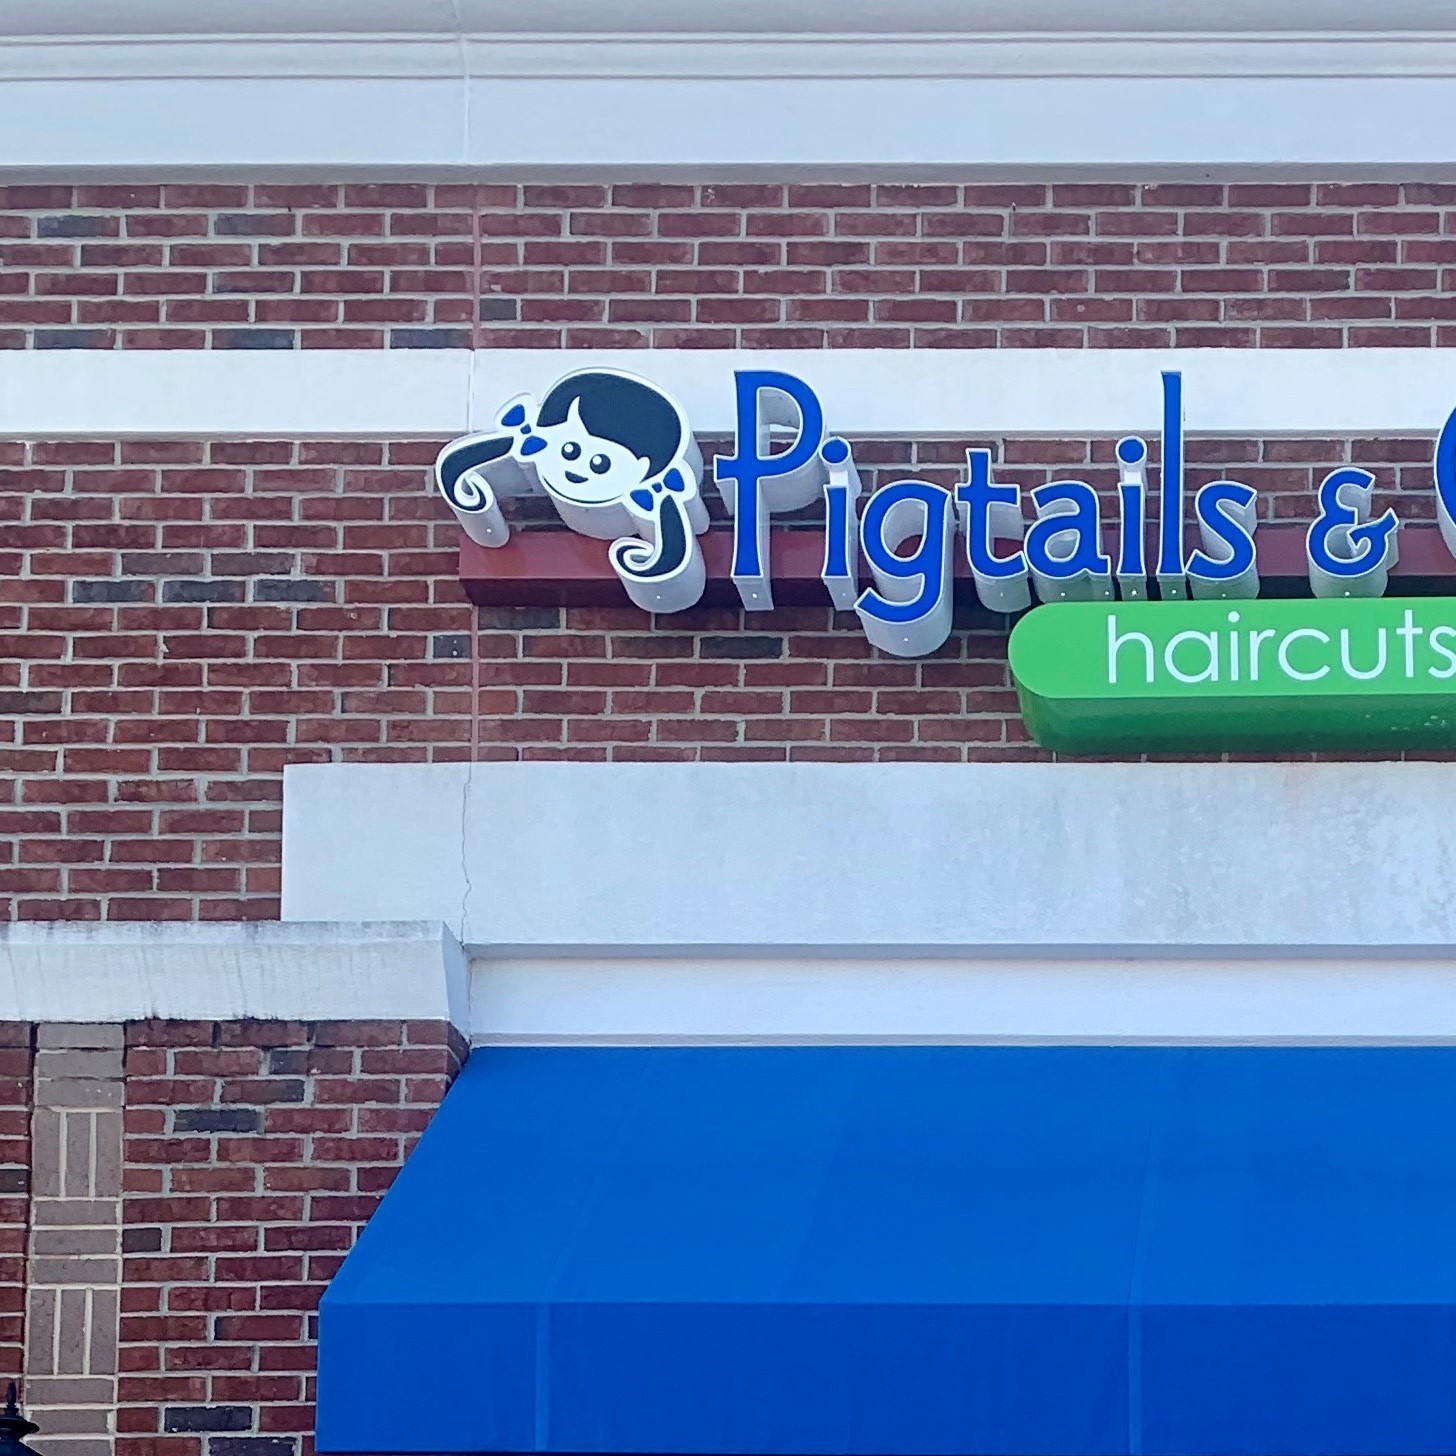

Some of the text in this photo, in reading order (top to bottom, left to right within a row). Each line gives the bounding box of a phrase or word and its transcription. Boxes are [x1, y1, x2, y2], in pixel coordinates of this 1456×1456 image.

[714, 368, 1256, 621] Pigtails
[1307, 467, 1400, 578] &
[1107, 611, 1456, 684] haircuts
